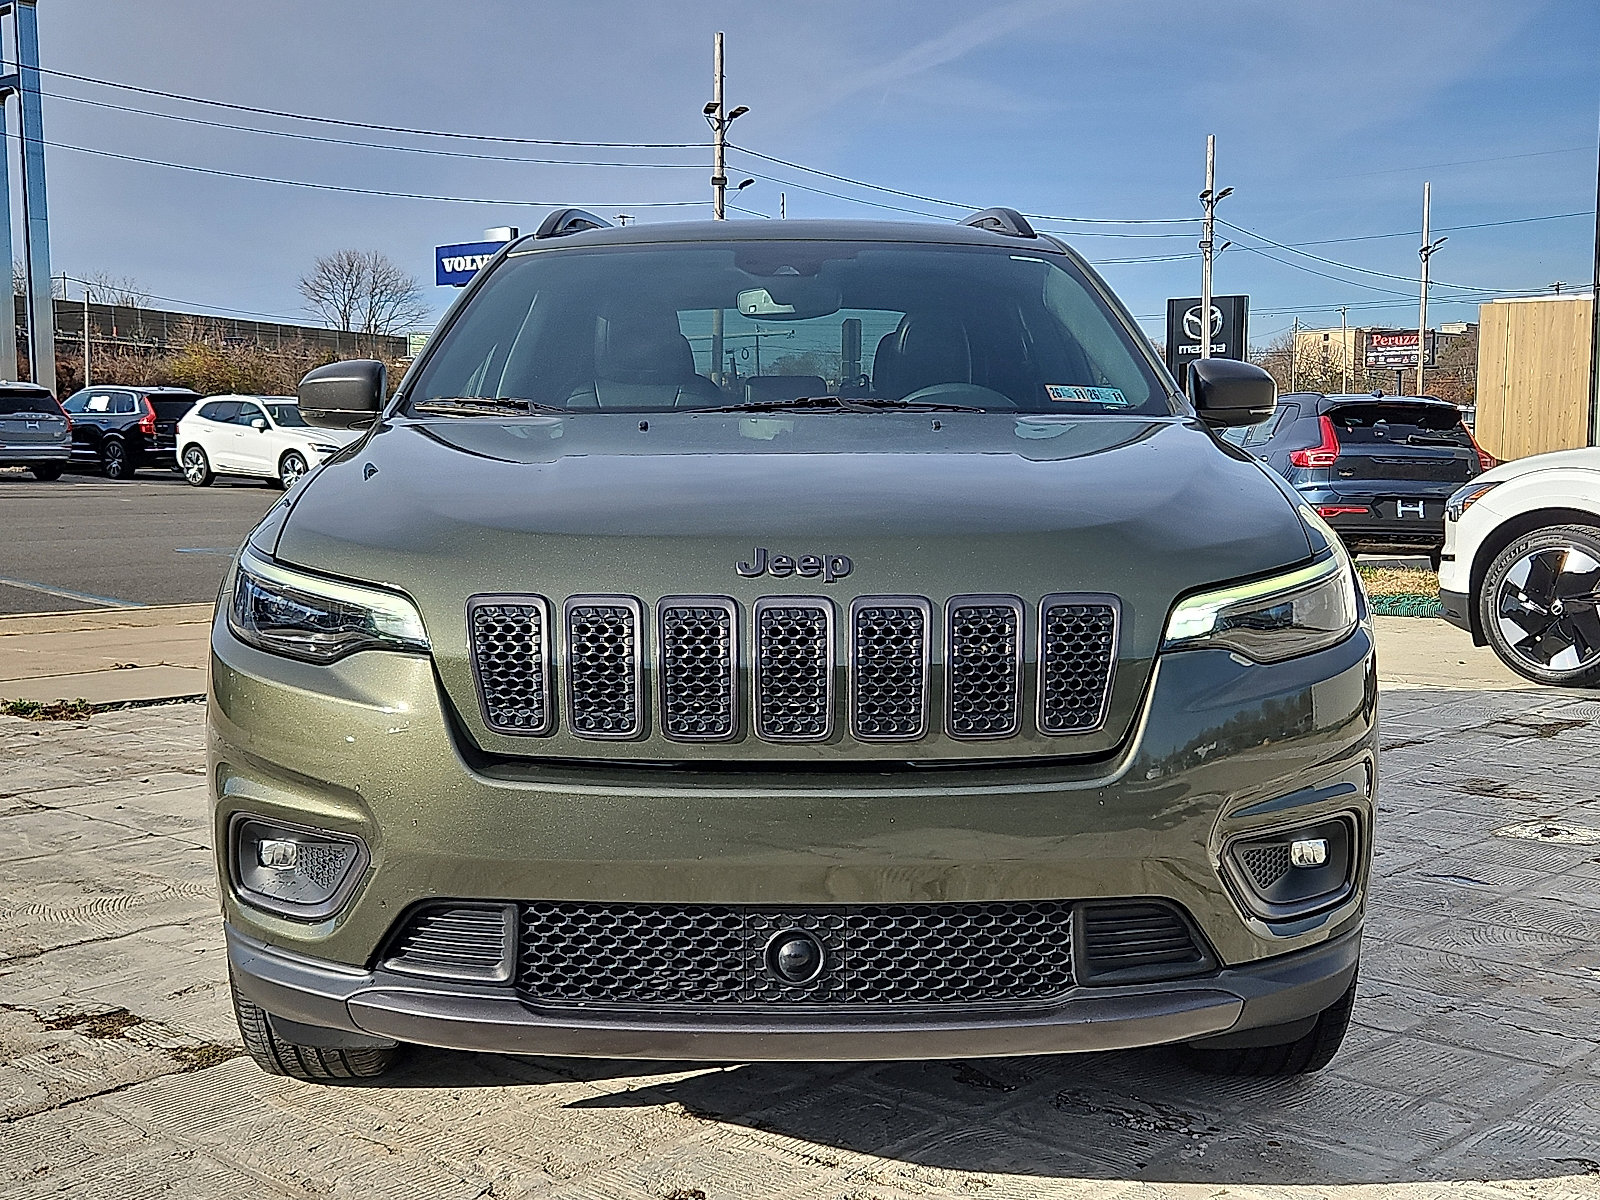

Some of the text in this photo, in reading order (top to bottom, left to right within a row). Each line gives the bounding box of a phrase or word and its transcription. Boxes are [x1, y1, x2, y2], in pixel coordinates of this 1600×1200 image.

[441, 253, 495, 273] VOLV
[1178, 342, 1227, 355] mada
[1371, 333, 1421, 347] Peruzz
[736, 547, 854, 584] Jeep
[1490, 543, 1528, 586] MICHELIN
